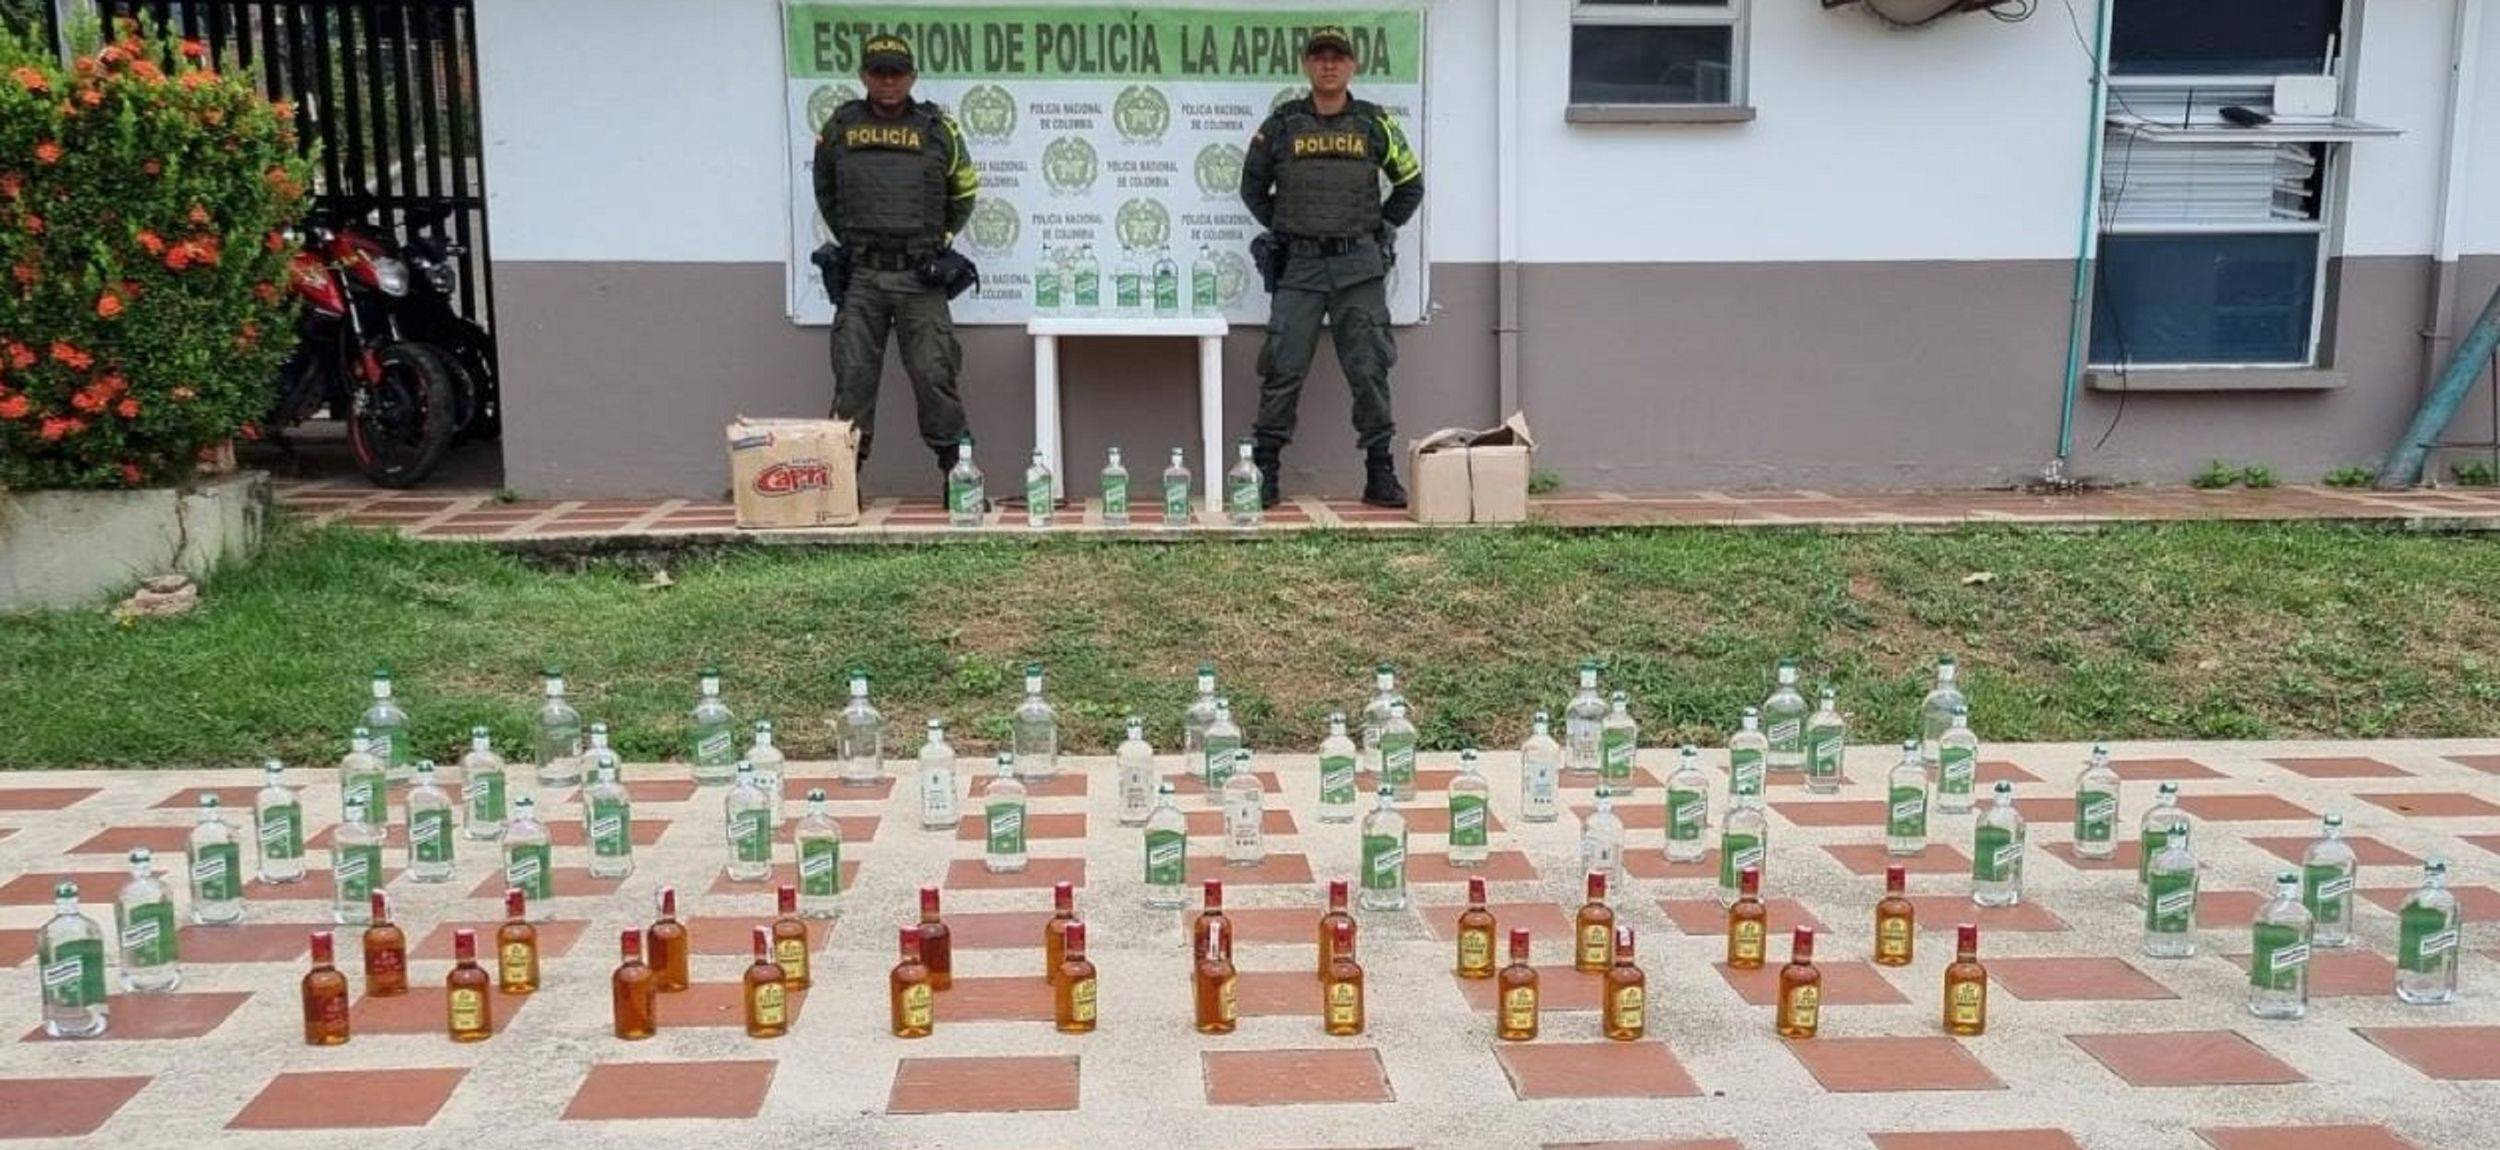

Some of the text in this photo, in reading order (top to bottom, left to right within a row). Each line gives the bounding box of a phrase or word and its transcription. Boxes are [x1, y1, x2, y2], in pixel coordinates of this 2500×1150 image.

[814, 11, 1391, 75] ESTION DE POLICÍA LA APARDA
[846, 127, 920, 148] POLICÍA
[1295, 133, 1364, 155] POLICÍA
